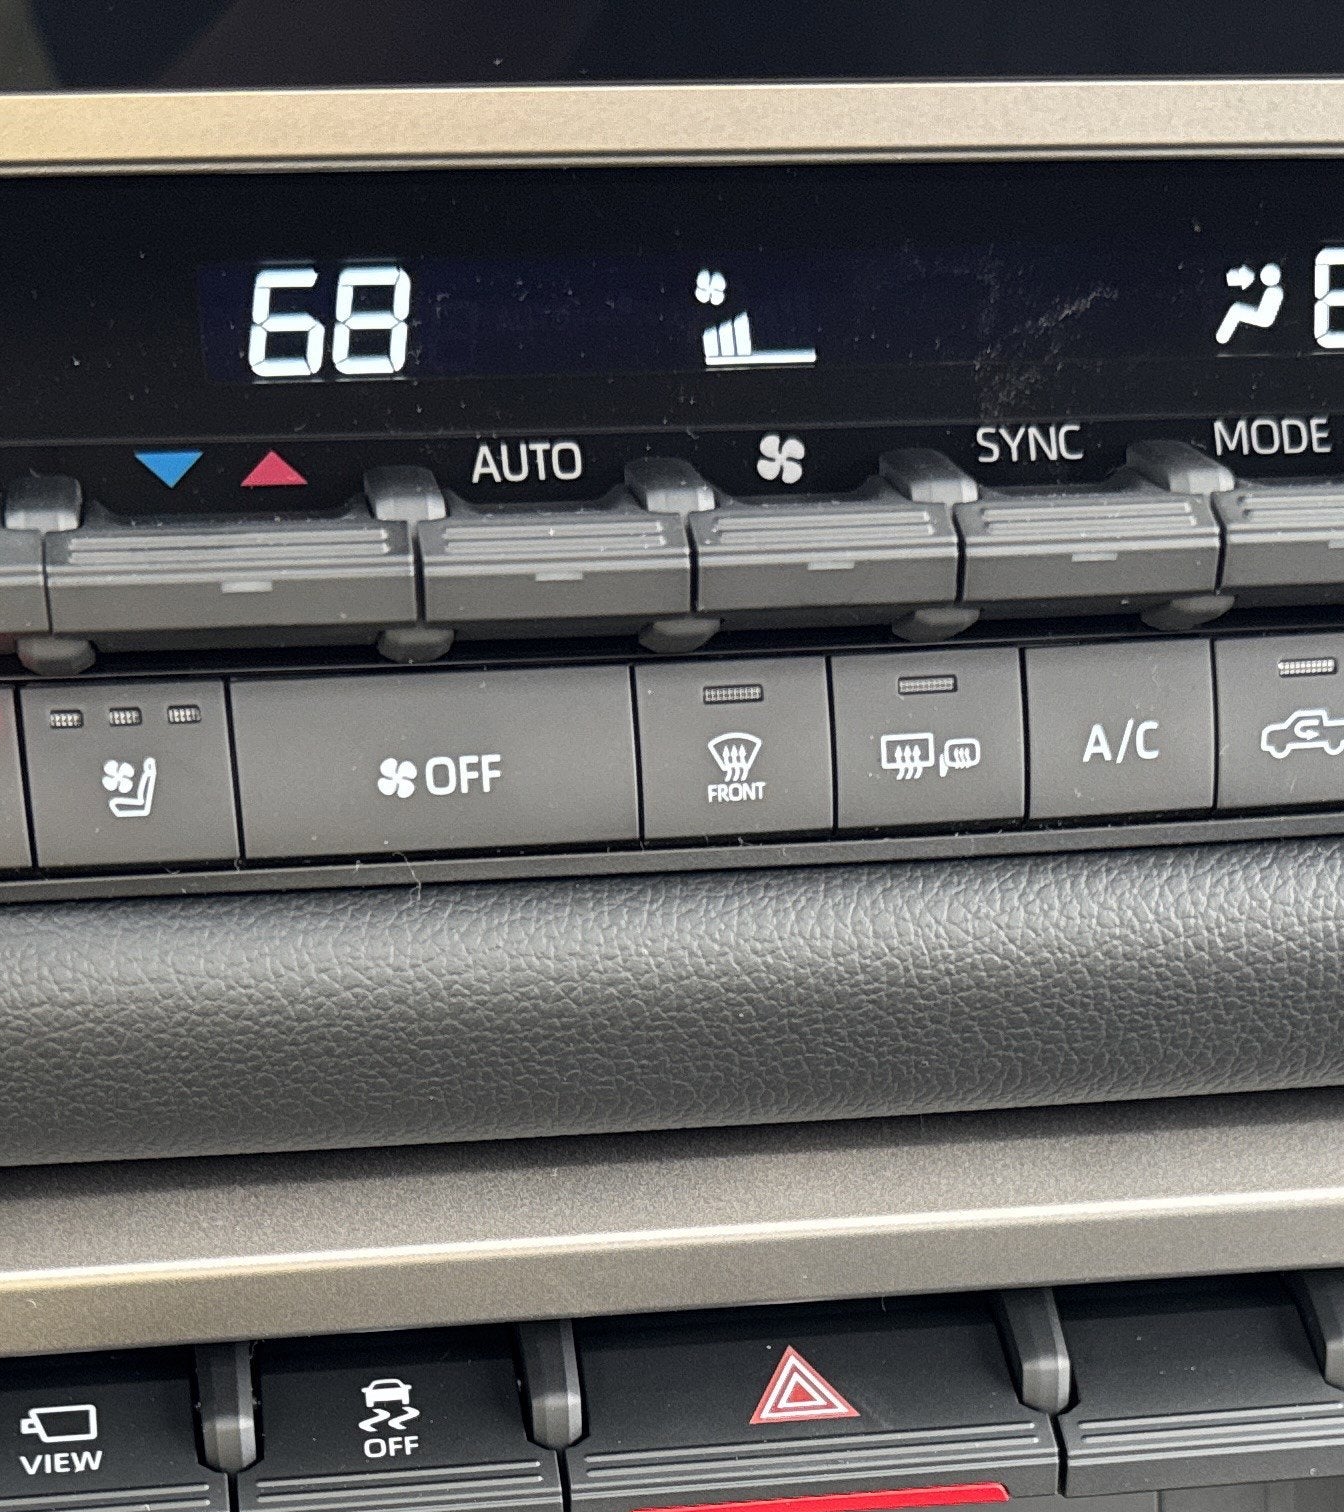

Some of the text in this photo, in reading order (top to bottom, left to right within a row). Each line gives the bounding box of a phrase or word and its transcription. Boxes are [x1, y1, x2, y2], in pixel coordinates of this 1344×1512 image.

[248, 266, 412, 378] 68
[976, 424, 1084, 463] SYNC
[1213, 417, 1332, 456] MODE
[471, 441, 582, 484] AUTO
[1082, 719, 1160, 764] A/C
[425, 753, 503, 796] OFF
[707, 781, 766, 803] FRONT
[19, 1450, 103, 1475] VIEW
[362, 1434, 419, 1459] OFF
